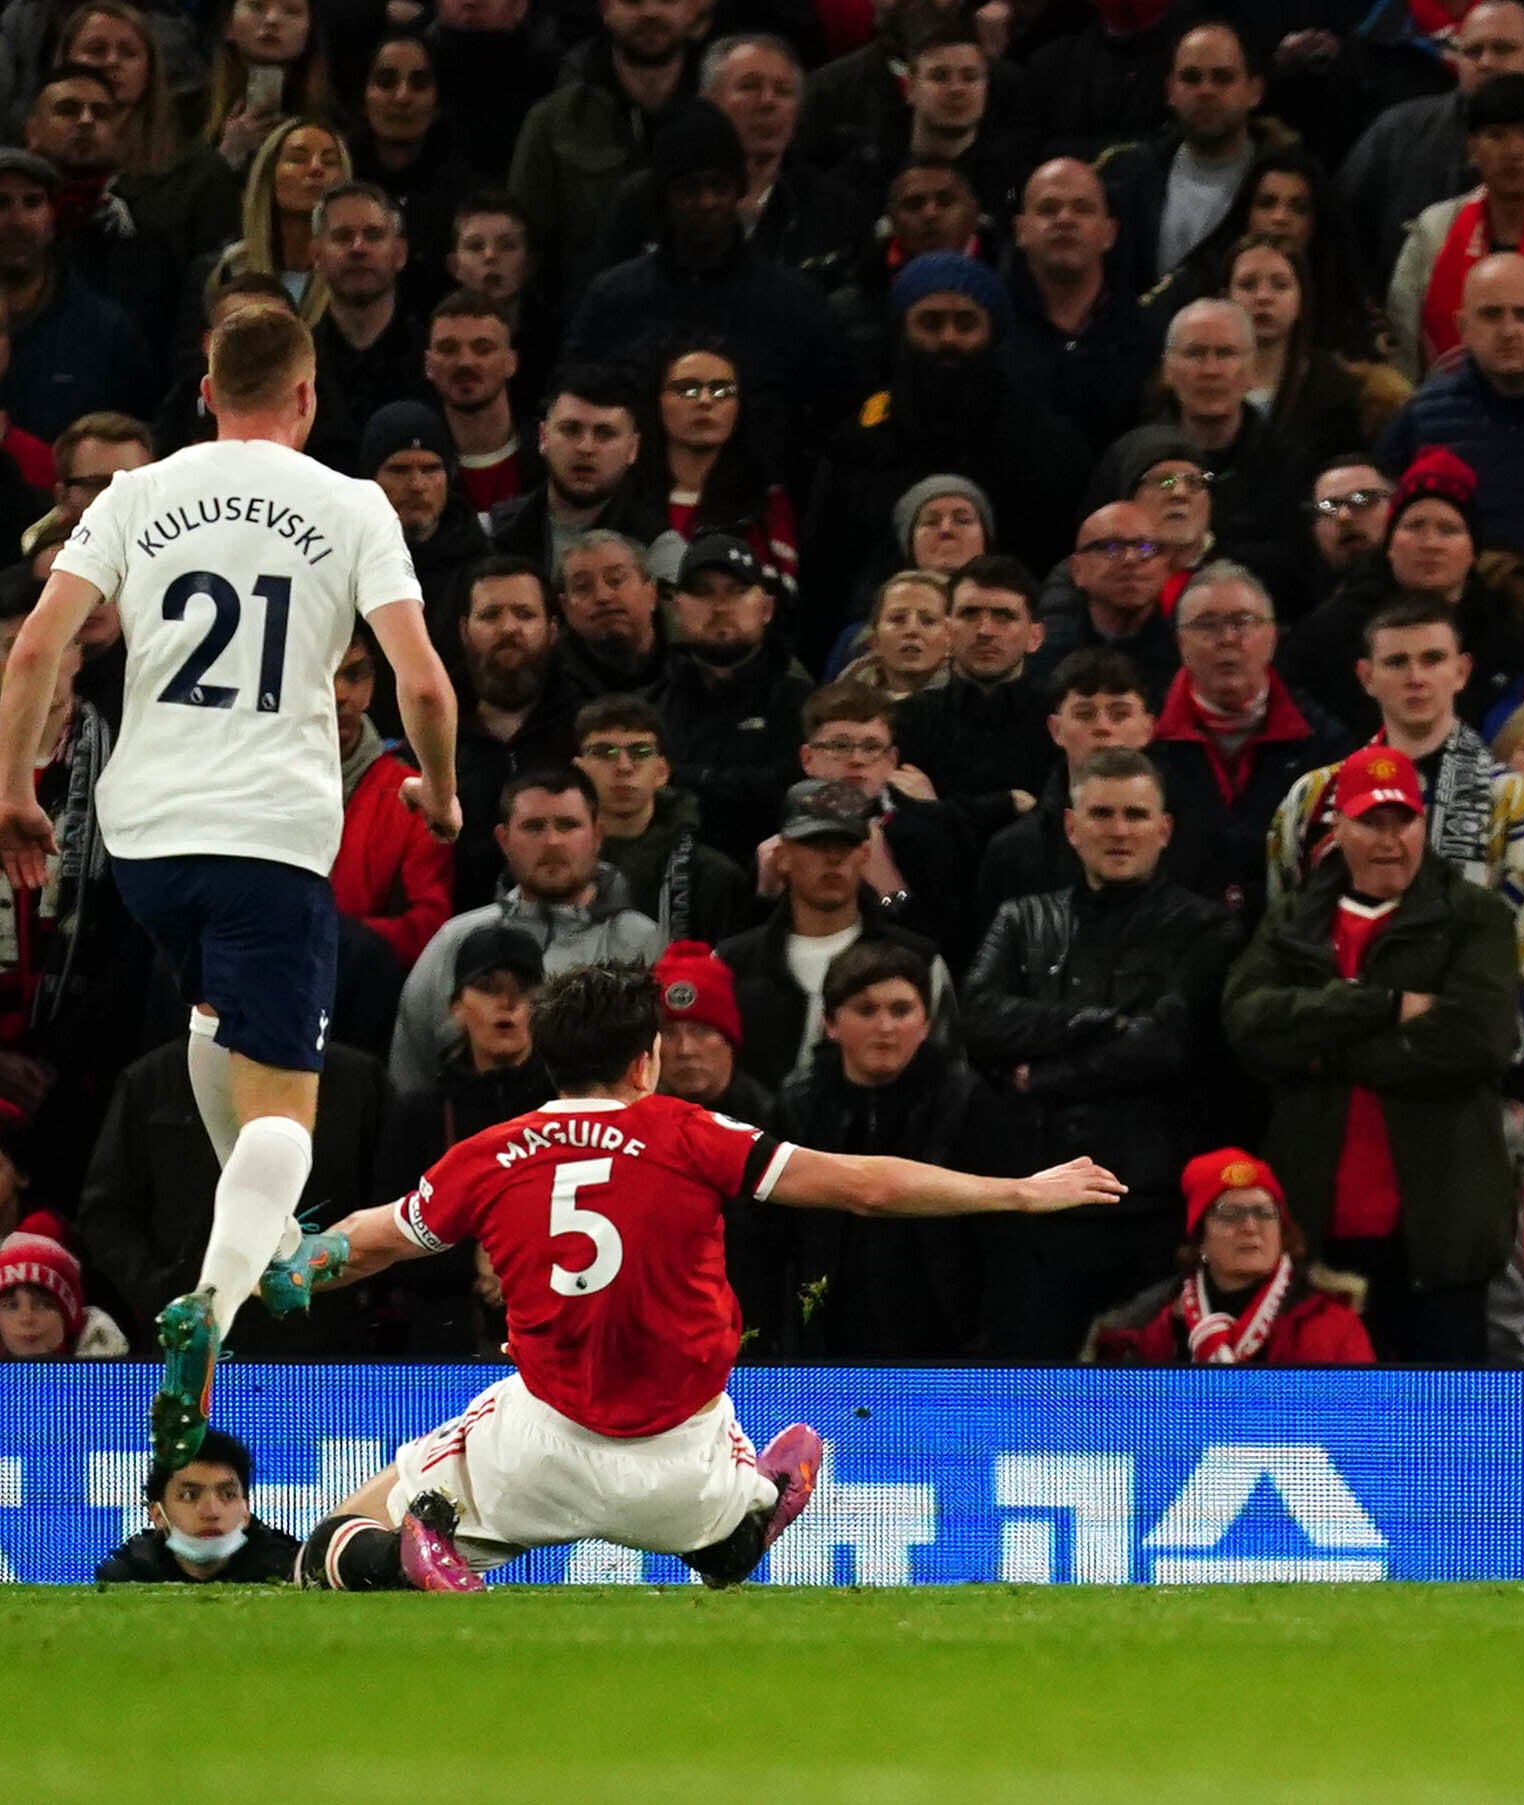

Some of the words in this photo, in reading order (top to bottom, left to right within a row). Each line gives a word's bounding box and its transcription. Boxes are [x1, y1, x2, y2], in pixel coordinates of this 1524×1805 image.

[137, 496, 333, 565] KULUSEVSKI
[156, 570, 293, 713] 21
[496, 1119, 646, 1168] MAGUIRE
[550, 1157, 623, 1297] 5
